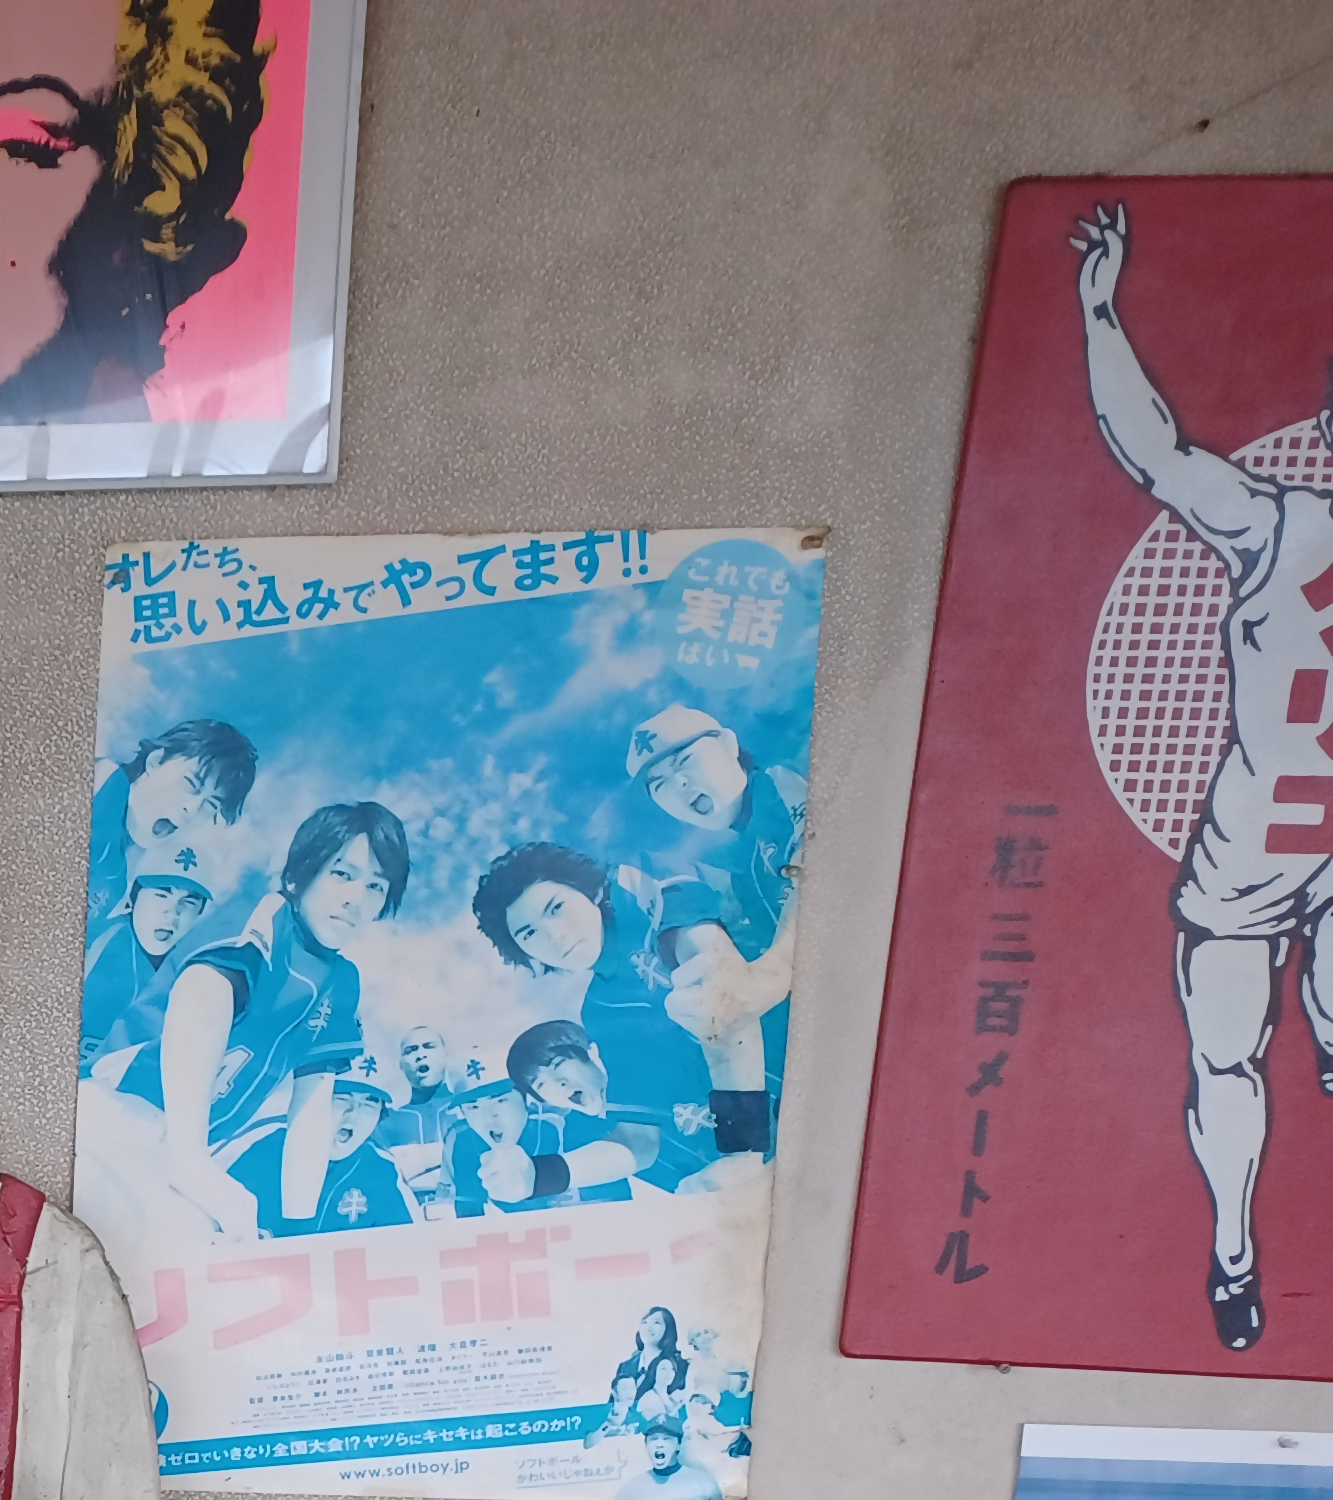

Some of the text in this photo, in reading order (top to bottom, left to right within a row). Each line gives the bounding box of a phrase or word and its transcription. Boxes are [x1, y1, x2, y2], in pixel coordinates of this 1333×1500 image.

[104, 540, 259, 594] オレたち、
[687, 556, 791, 595] これでも
[676, 587, 785, 649] 実話
[339, 1459, 470, 1482] www.softboy.jp
